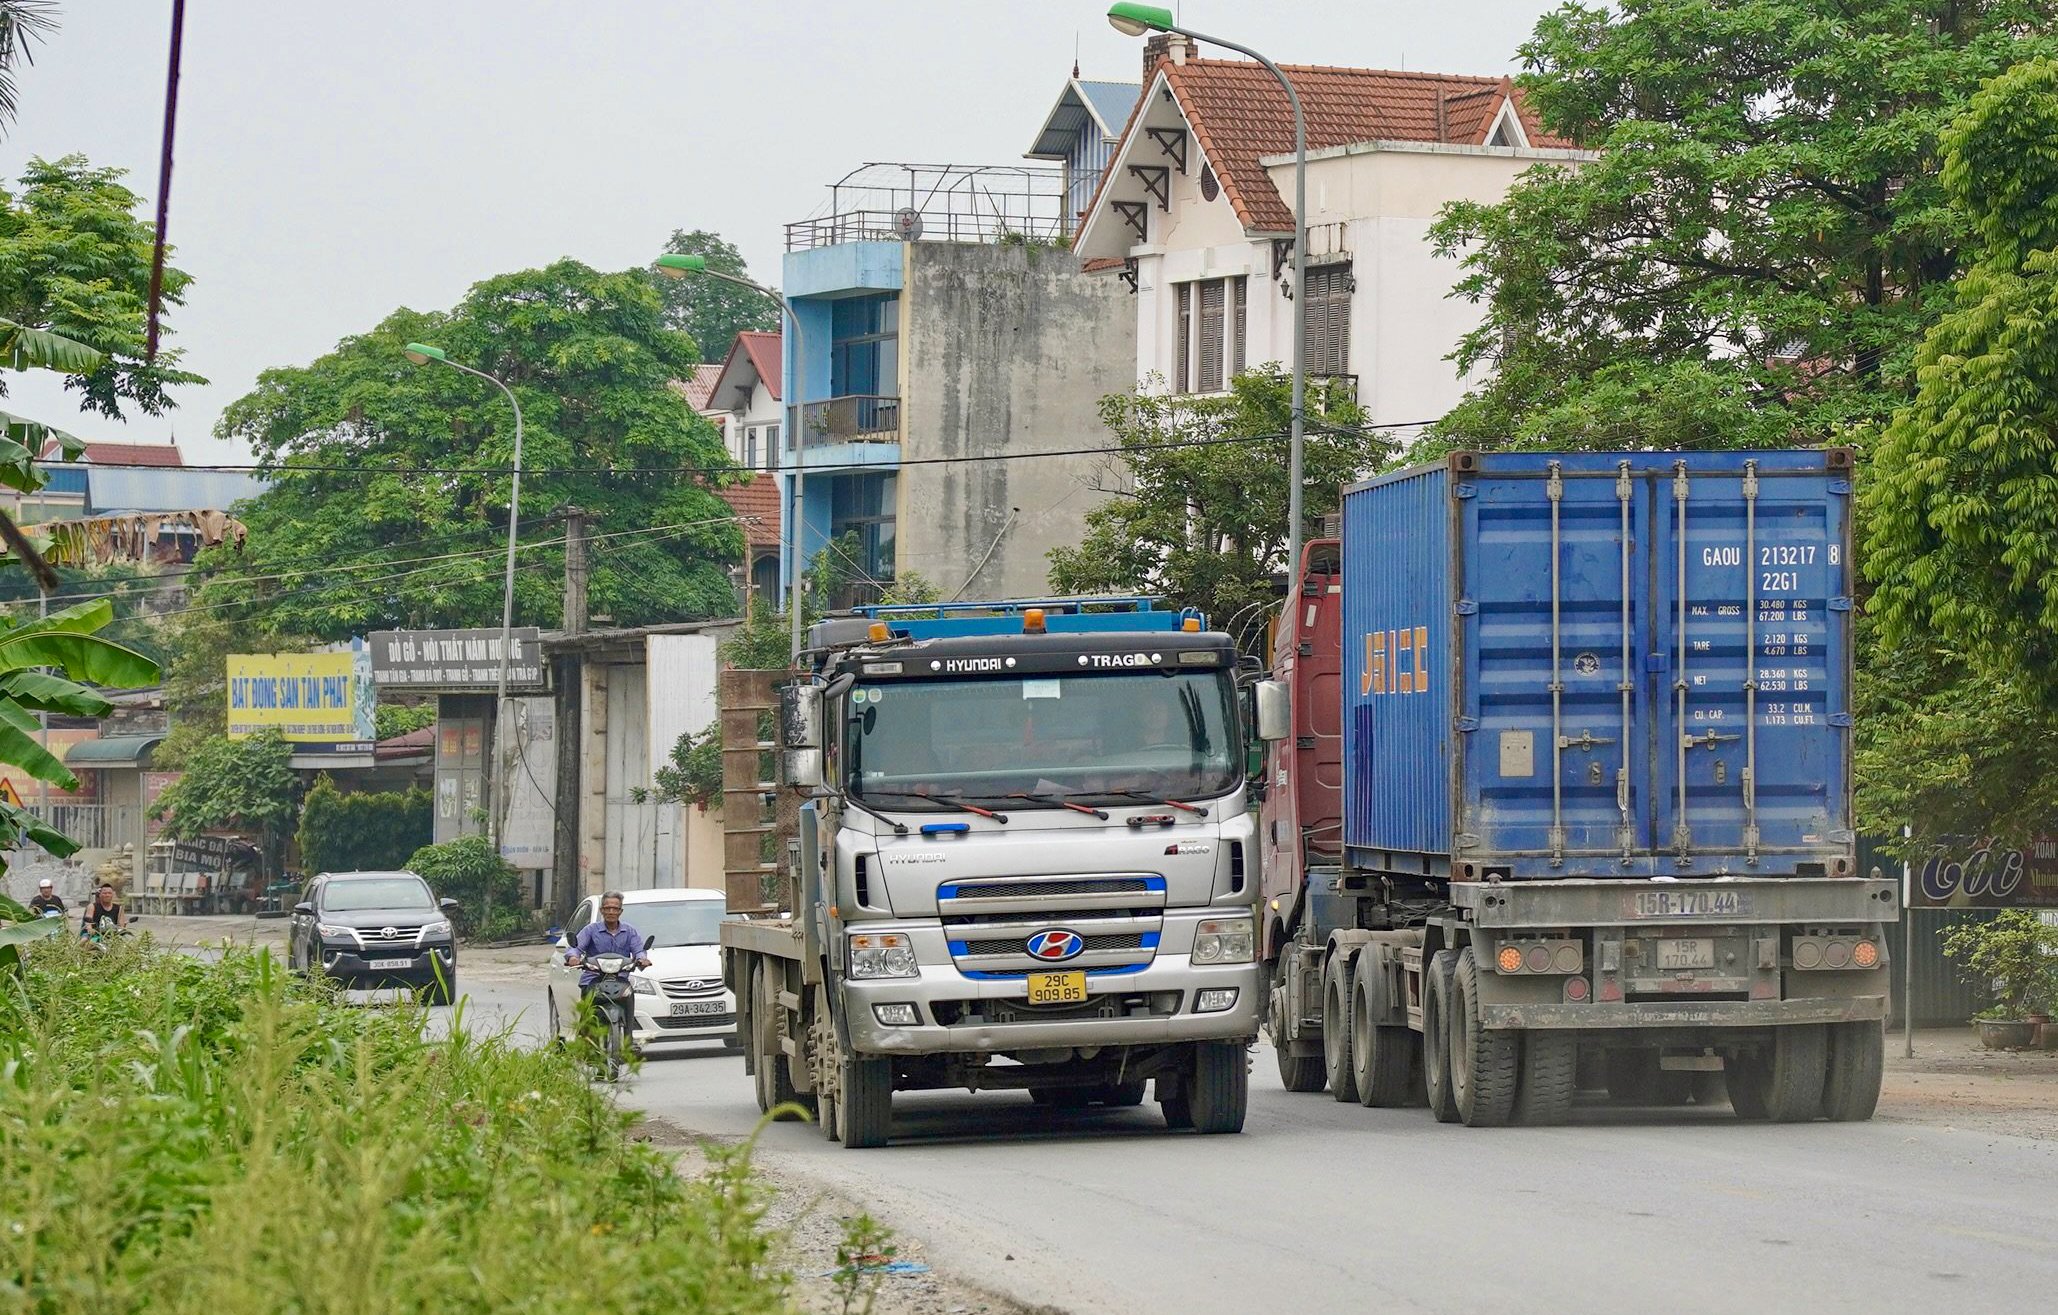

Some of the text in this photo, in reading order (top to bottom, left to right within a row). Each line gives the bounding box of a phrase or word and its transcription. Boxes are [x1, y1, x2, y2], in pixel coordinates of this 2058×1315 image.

[1703, 545, 1839, 566] GAOU 213217 8
[1762, 572, 1797, 591] 22G1
[1759, 599, 1807, 609] 30.480 KGS
[1691, 605, 1740, 616] MAX. GROSS
[1759, 611, 1807, 621] 67.200 LBS
[1764, 634, 1808, 644] 2.120 KGS
[1693, 641, 1711, 650] TARE
[1763, 646, 1808, 656] 4.670 LBS
[946, 653, 1147, 672] HYUNDAI TRAGO
[1694, 675, 1707, 685] NET
[1759, 669, 1808, 679] 28.360 KGS
[231, 666, 249, 709] BẤT
[252, 670, 277, 716] ĐỘNG
[280, 663, 299, 709] SẢN
[323, 668, 348, 709] PHÁT
[1760, 680, 1808, 691] 62.530 LBS
[1767, 703, 1785, 713] 33.2
[1765, 715, 1786, 725] 1.173
[175, 849, 197, 863] BIA
[889, 853, 946, 865] HYUNDAI
[1638, 891, 1736, 915] 15R-170.44
[1674, 941, 1698, 953] 15R
[1665, 954, 1707, 967] 170.44
[1044, 975, 1069, 988] 29C
[1035, 988, 1080, 1002] 909.85
[672, 1002, 724, 1015] 29A-342.35
